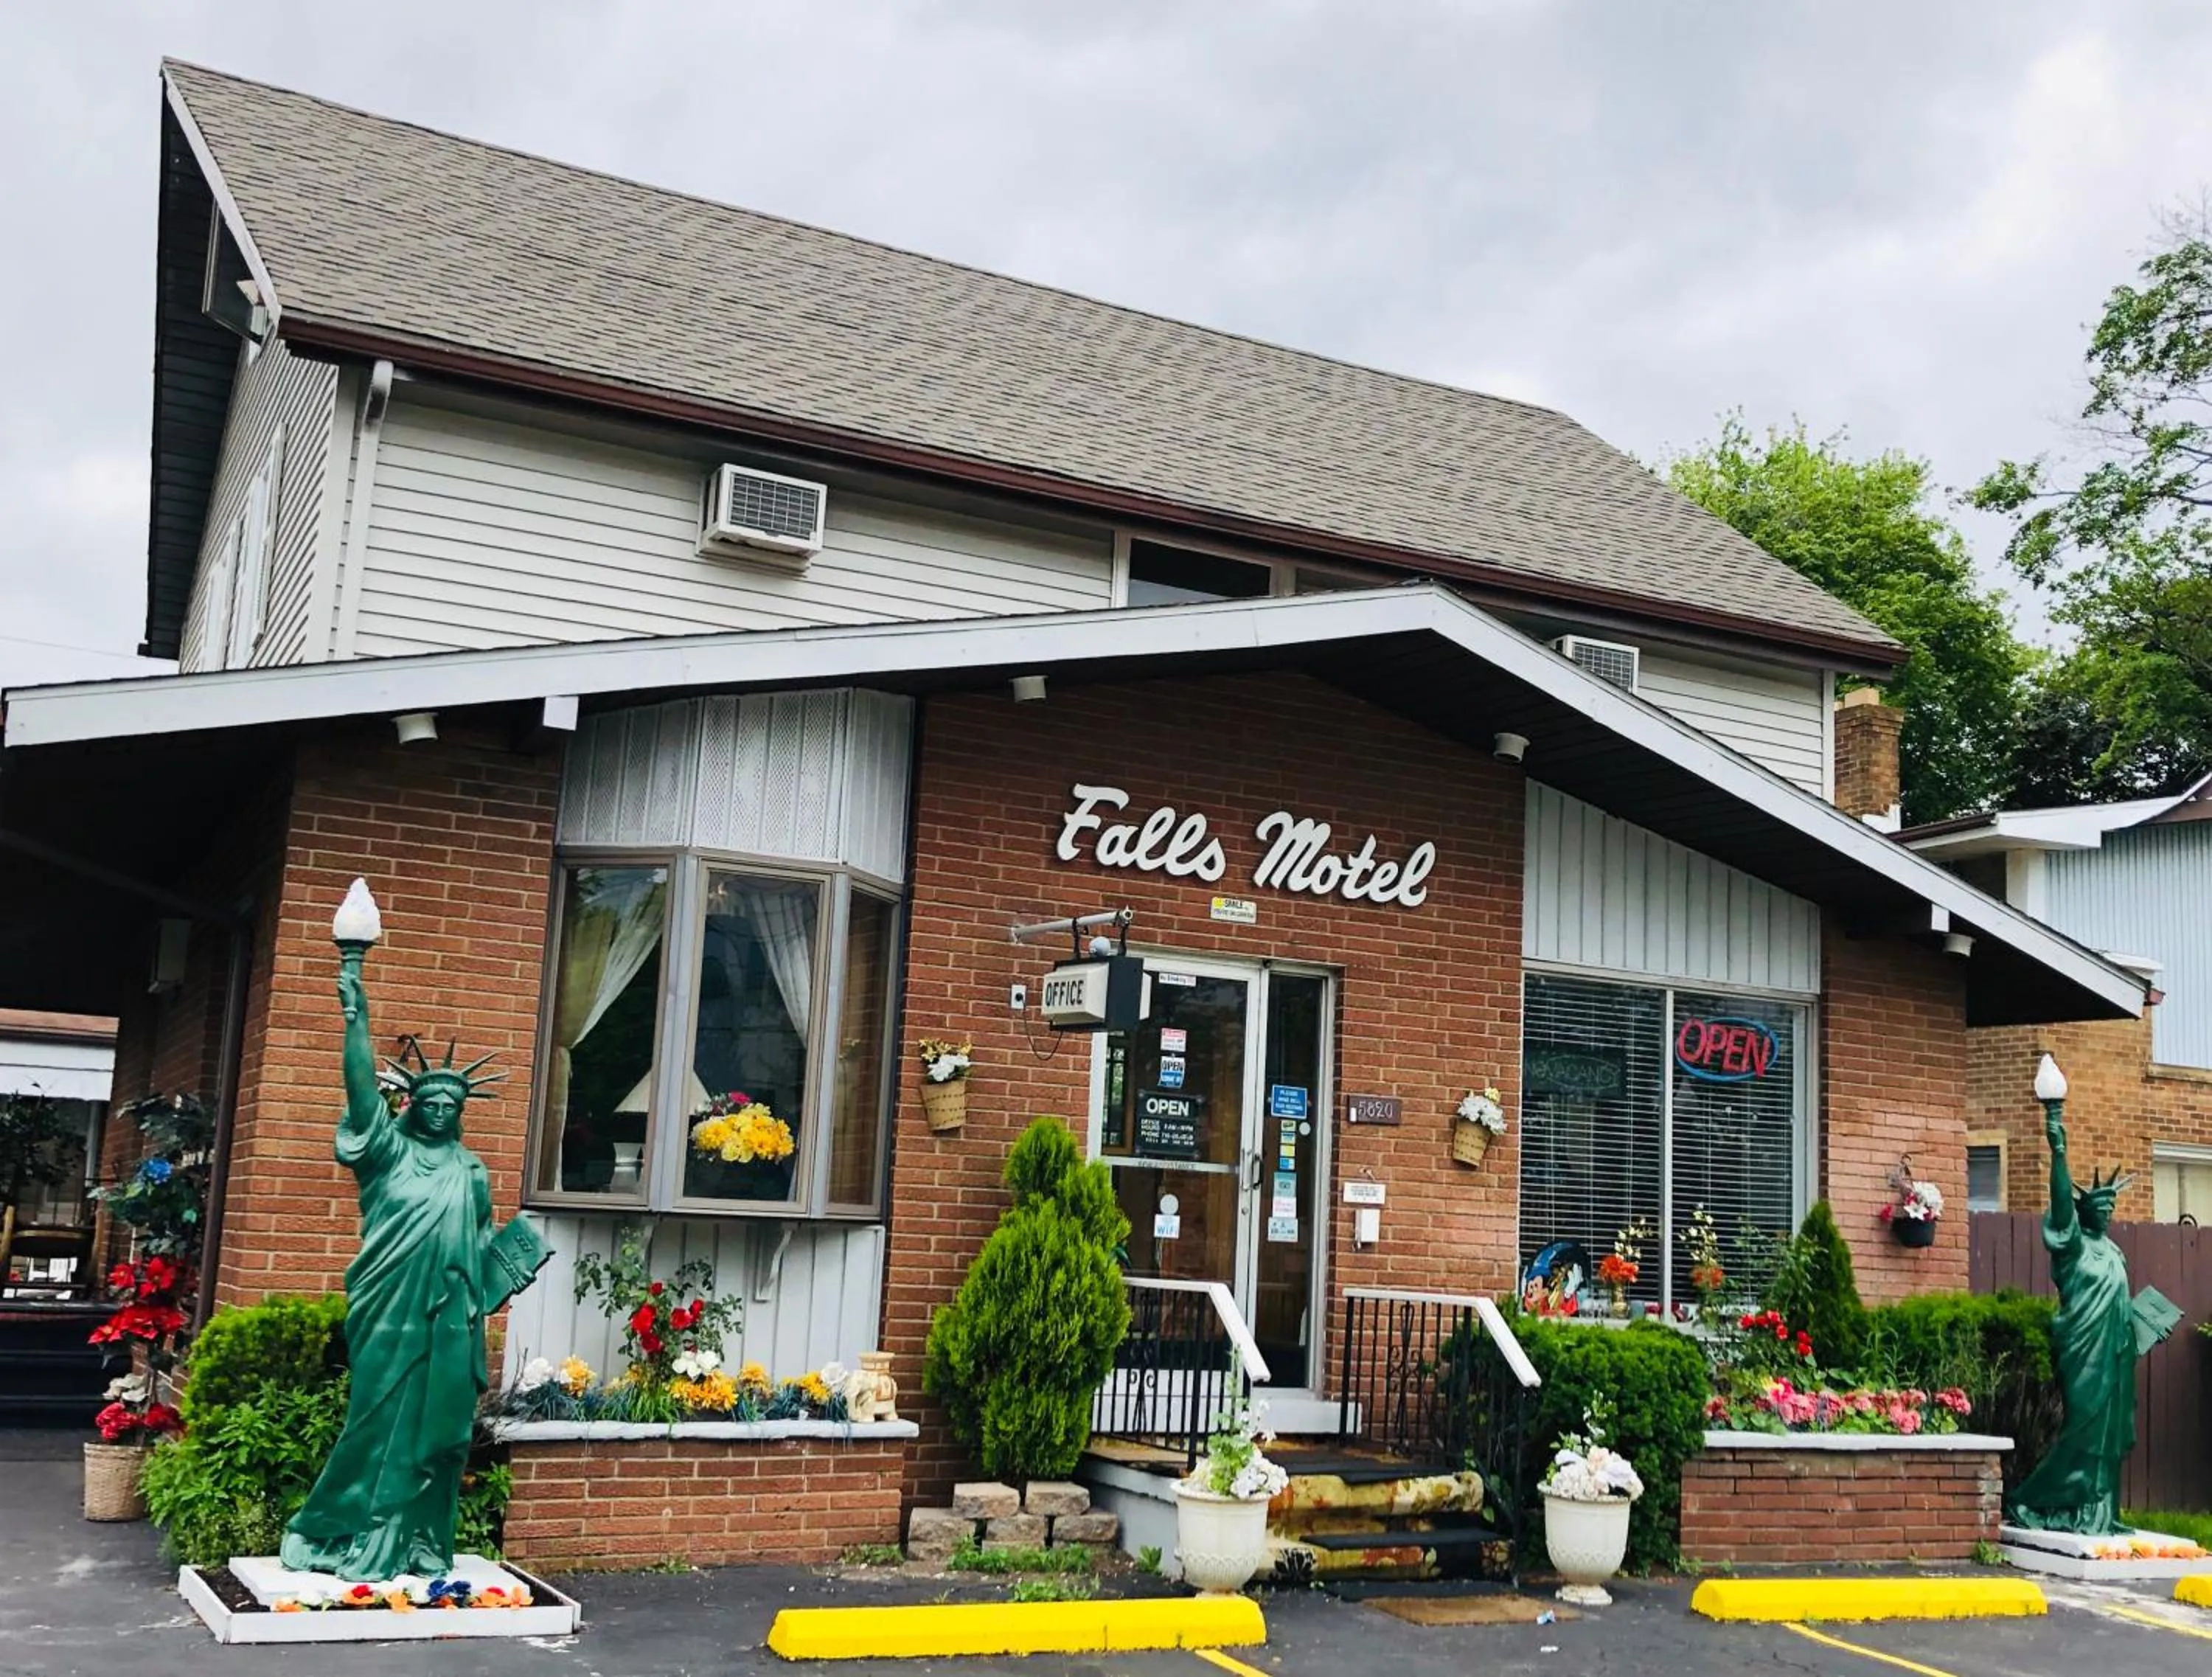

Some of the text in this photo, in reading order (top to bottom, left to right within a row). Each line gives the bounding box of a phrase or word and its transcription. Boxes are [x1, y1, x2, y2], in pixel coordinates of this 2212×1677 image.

[1057, 782, 1436, 907] Falls Motel
[1046, 979, 1084, 1007] OFFICE
[1677, 1017, 1771, 1077] OPEN
[1546, 1062, 1621, 1086] VACANCY
[1146, 1097, 1189, 1117] OPEN
